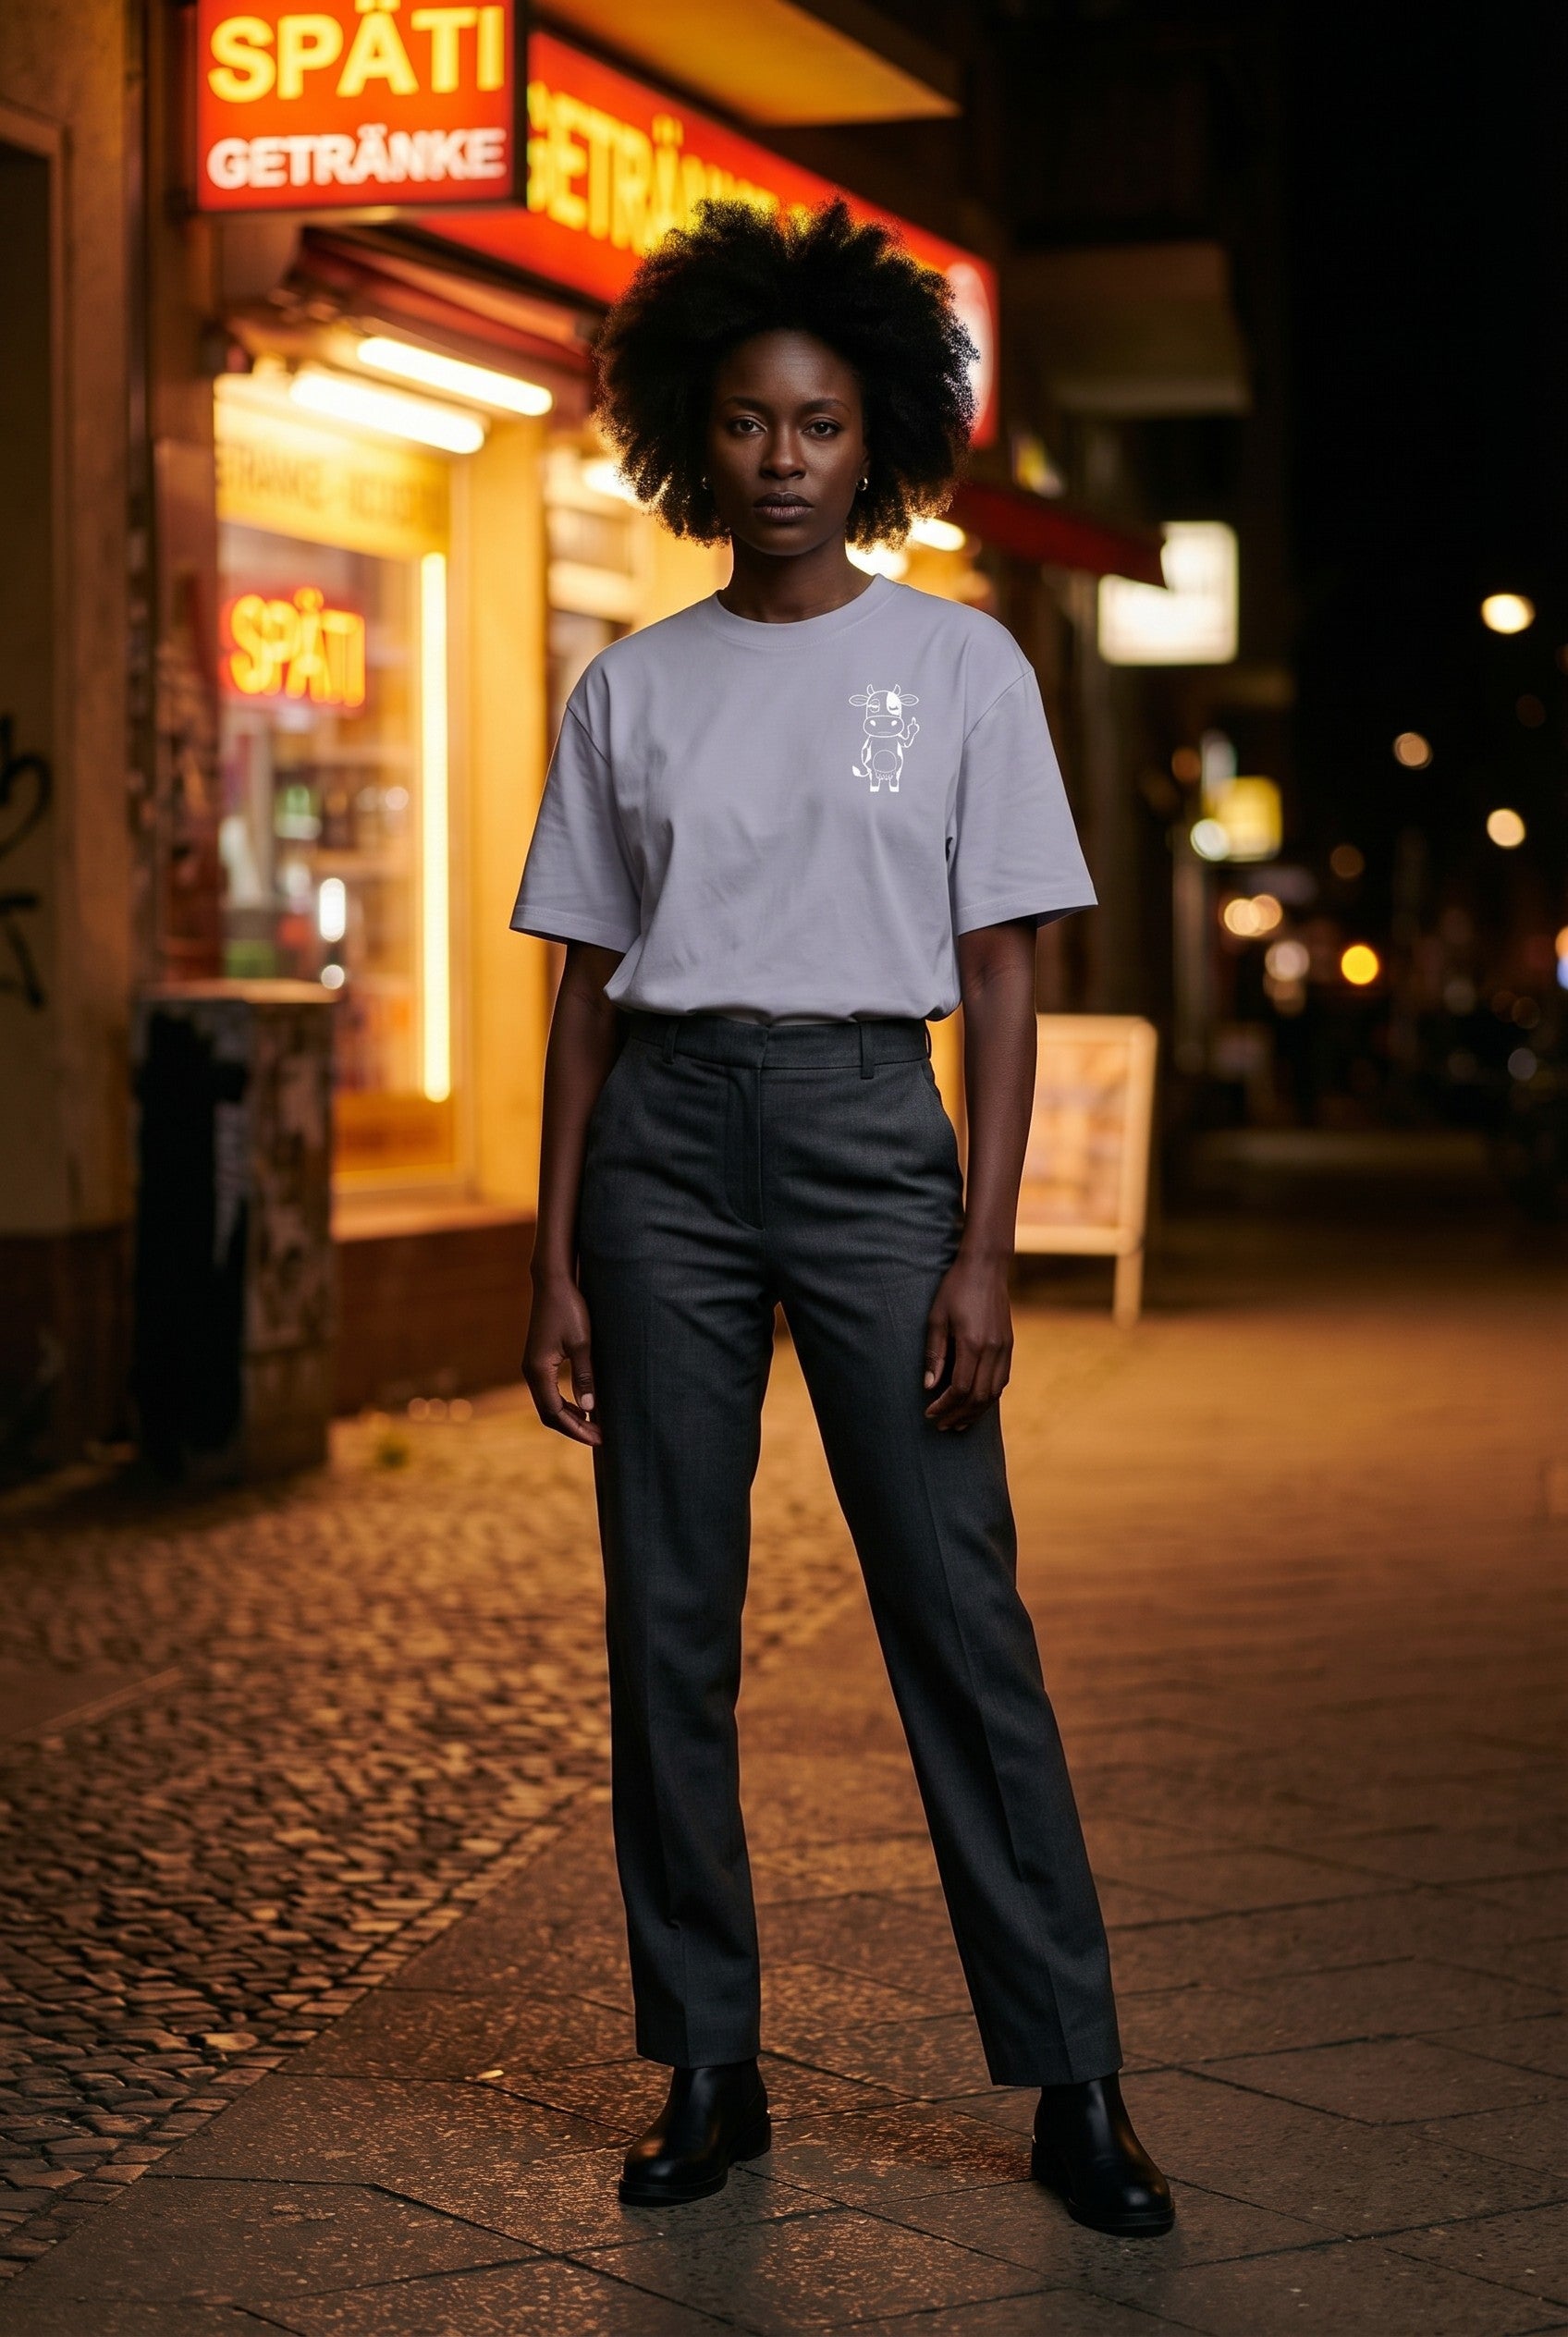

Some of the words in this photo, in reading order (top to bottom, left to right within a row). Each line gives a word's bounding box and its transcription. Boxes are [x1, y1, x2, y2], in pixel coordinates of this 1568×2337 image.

[207, 0, 505, 103] SPÄTI
[207, 123, 507, 190] GETRÄNKE
[229, 587, 366, 708] SPÄTI
